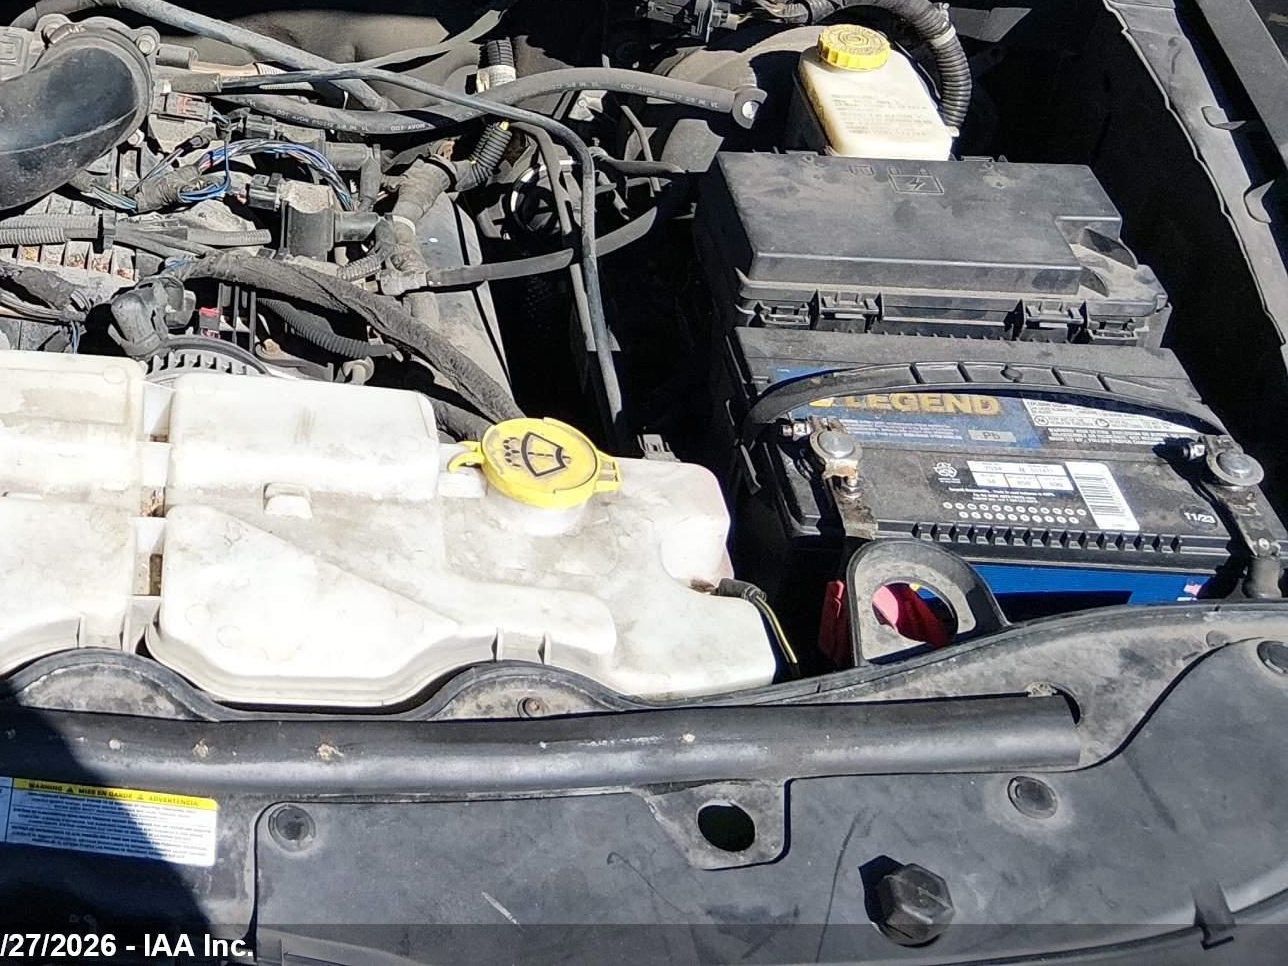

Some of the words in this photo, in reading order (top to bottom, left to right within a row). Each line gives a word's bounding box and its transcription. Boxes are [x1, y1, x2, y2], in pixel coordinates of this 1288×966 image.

[407, 122, 426, 131] AVON
[843, 392, 1001, 415] LEGEND
[982, 431, 1001, 440] Pb
[1184, 512, 1217, 524] 11/23
[28, 782, 63, 792] WARNING
[78, 787, 96, 796] MISE
[97, 789, 107, 797] EN
[108, 790, 133, 799] GARDE
[149, 795, 200, 807] ADVERTENCIA
